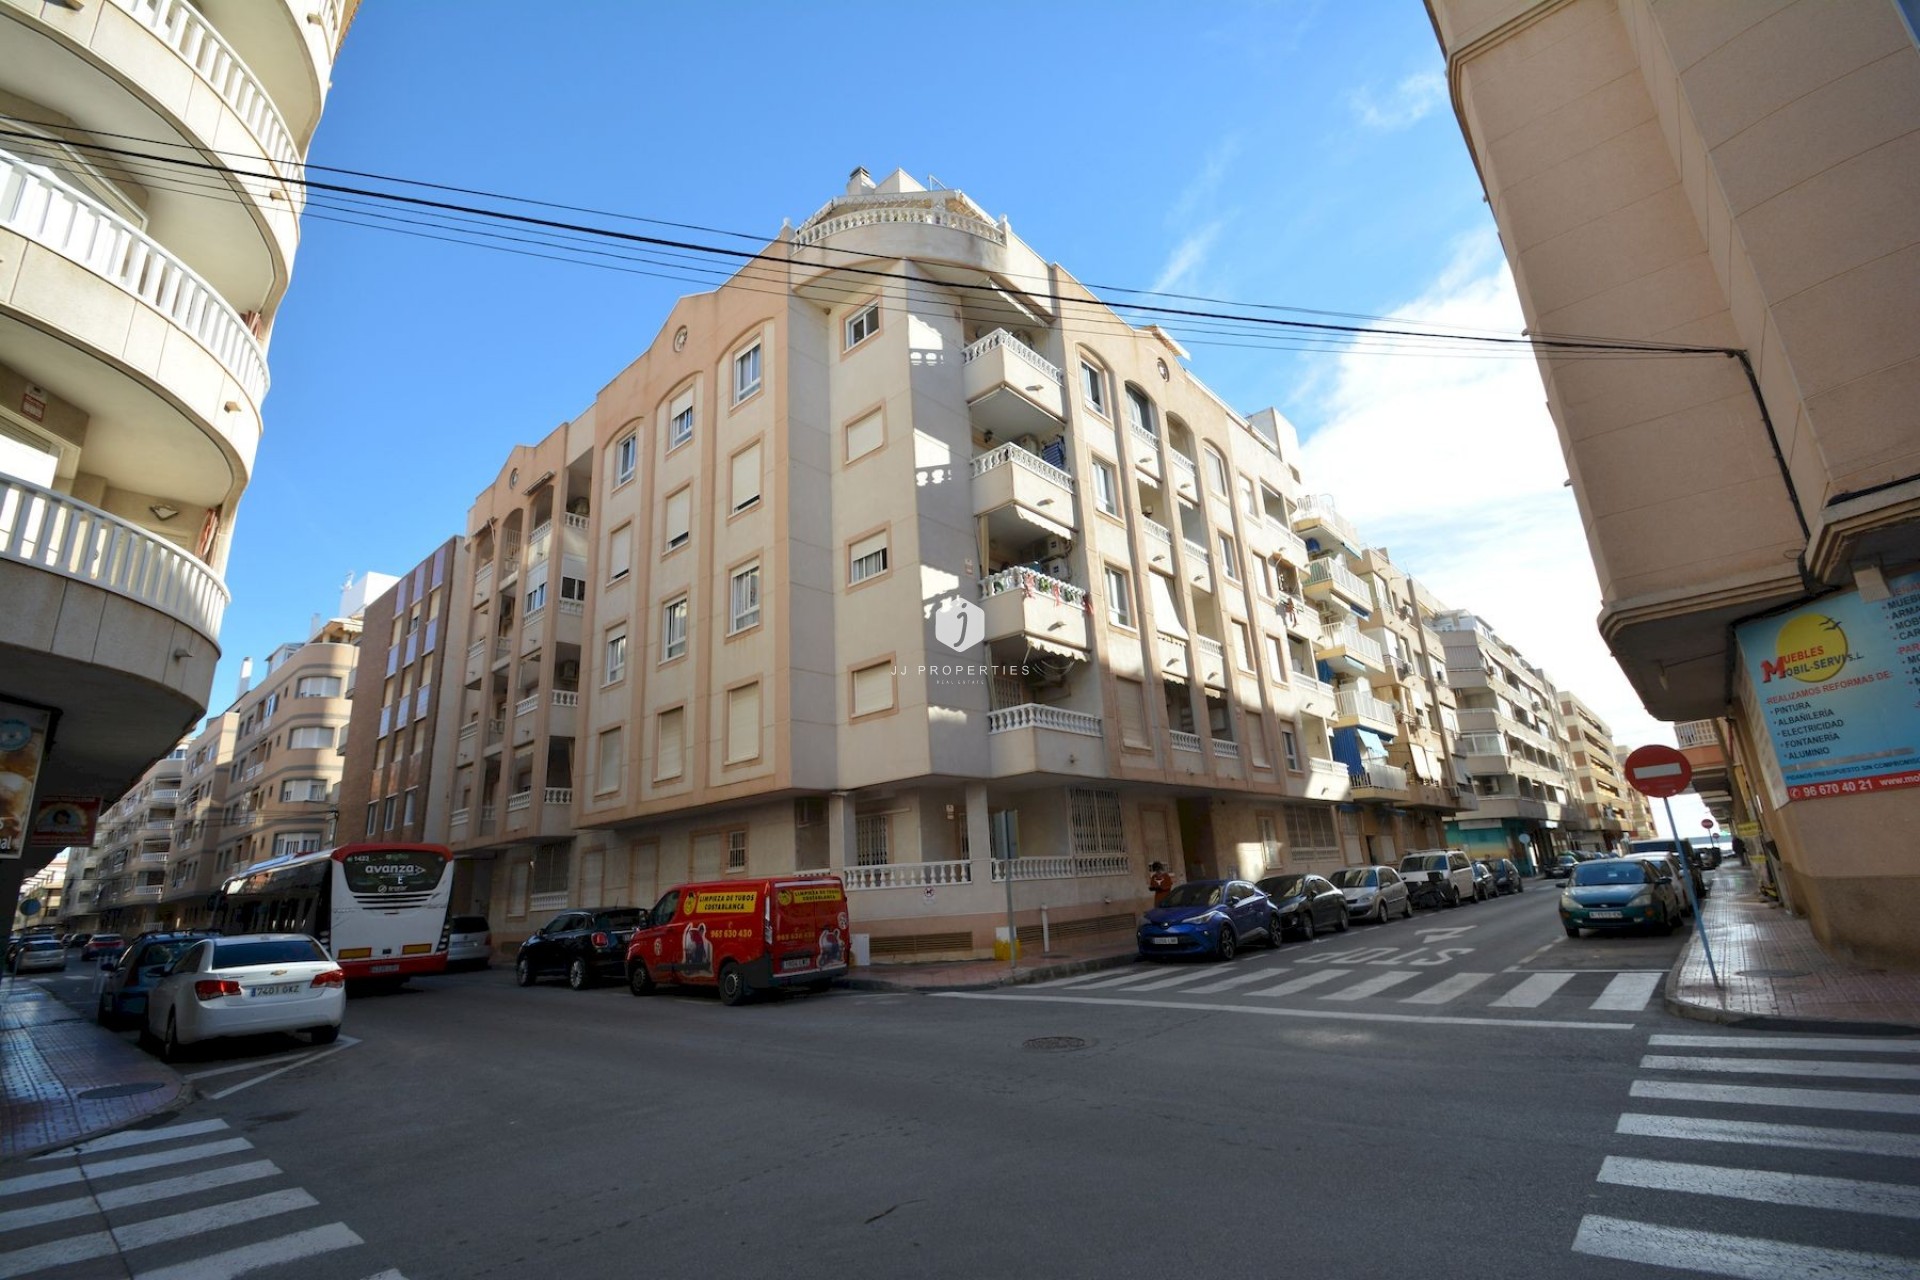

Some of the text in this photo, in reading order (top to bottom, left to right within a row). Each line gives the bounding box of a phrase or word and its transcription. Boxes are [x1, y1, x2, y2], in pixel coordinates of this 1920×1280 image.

[1895, 617, 1920, 630] MOB
[1823, 673, 1874, 693] REFORMAS
[1774, 702, 1811, 715] PINTURA
[1781, 719, 1844, 737] ELECTRICIDAD
[1788, 746, 1830, 760] ALUMINIO
[1803, 773, 1920, 797] 96 670 40 21 www.mo
[365, 864, 414, 874] avanza
